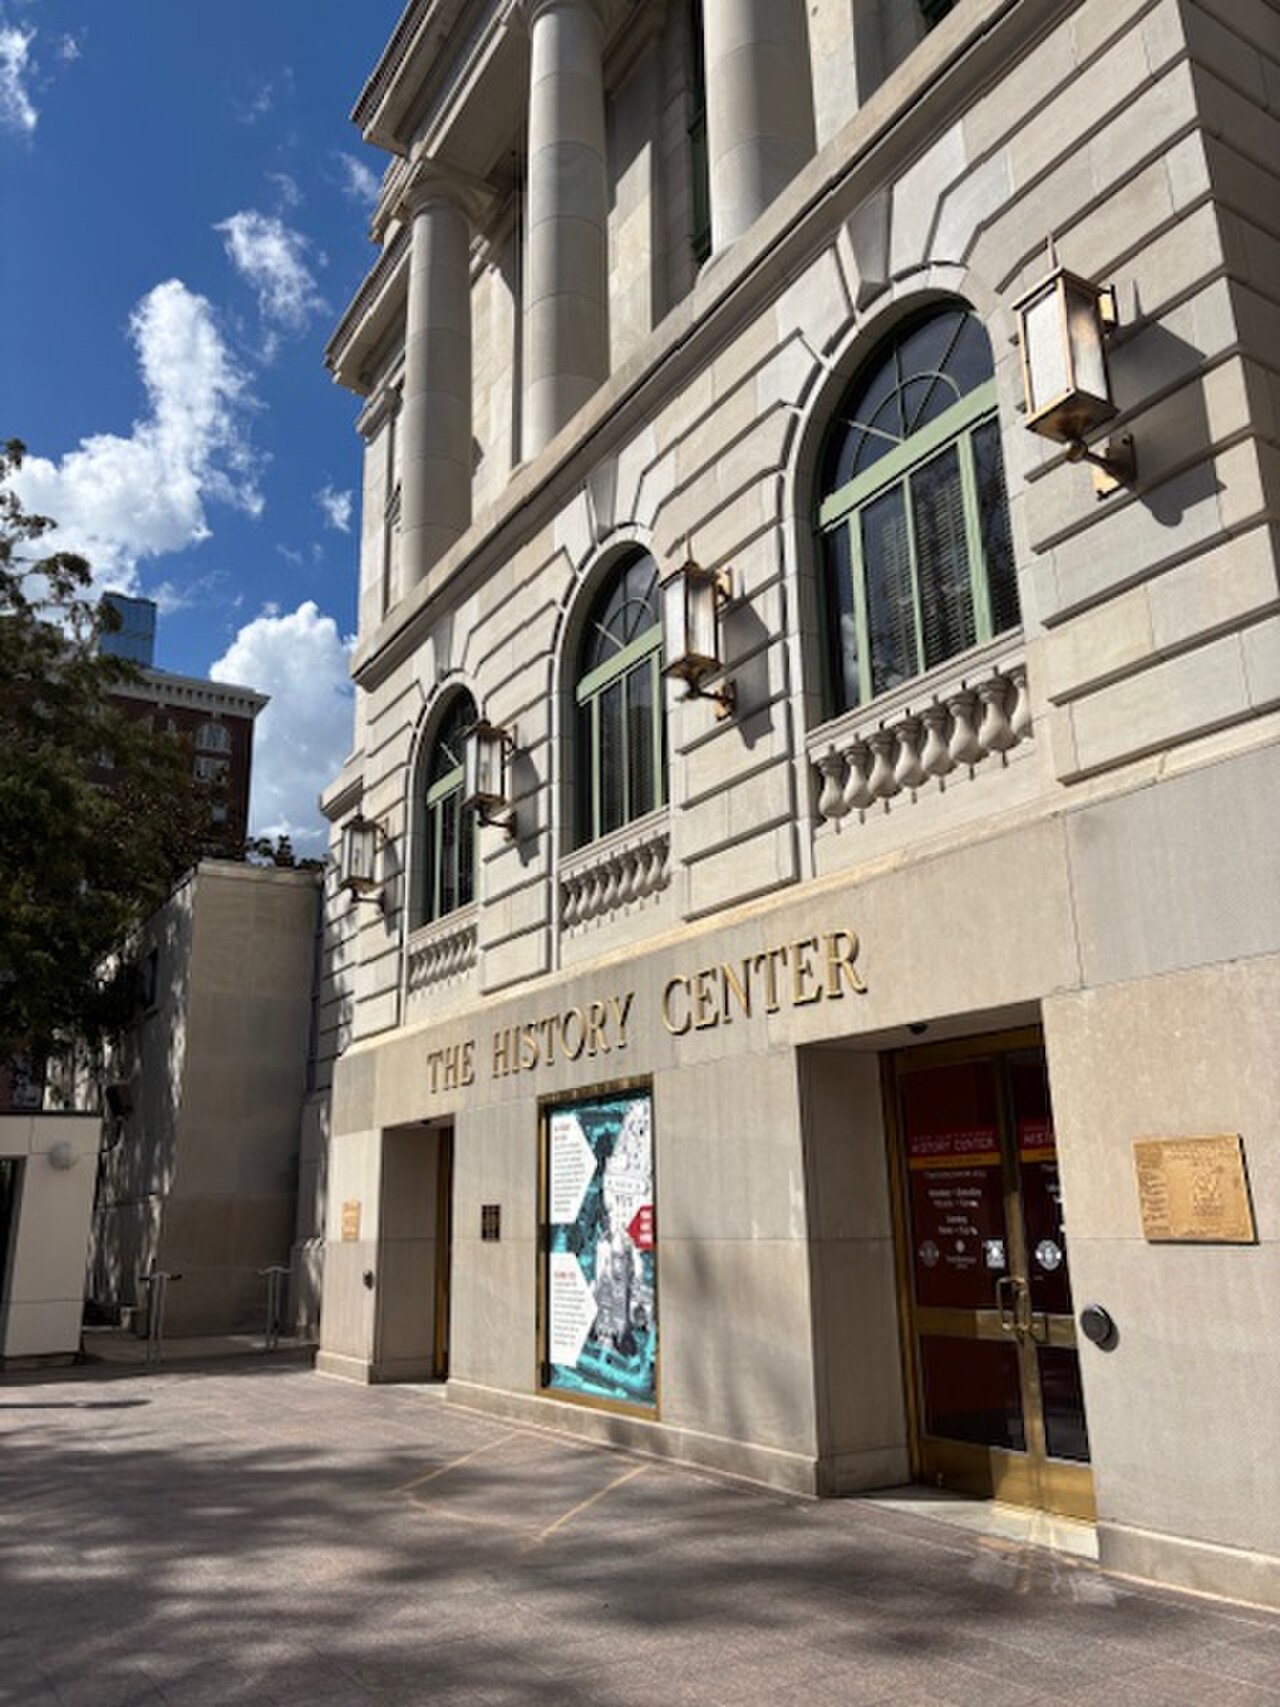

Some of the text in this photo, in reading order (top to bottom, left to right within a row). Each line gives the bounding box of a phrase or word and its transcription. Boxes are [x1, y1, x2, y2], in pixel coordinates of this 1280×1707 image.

[427, 928, 868, 1094] THE HISTORY CENTER
